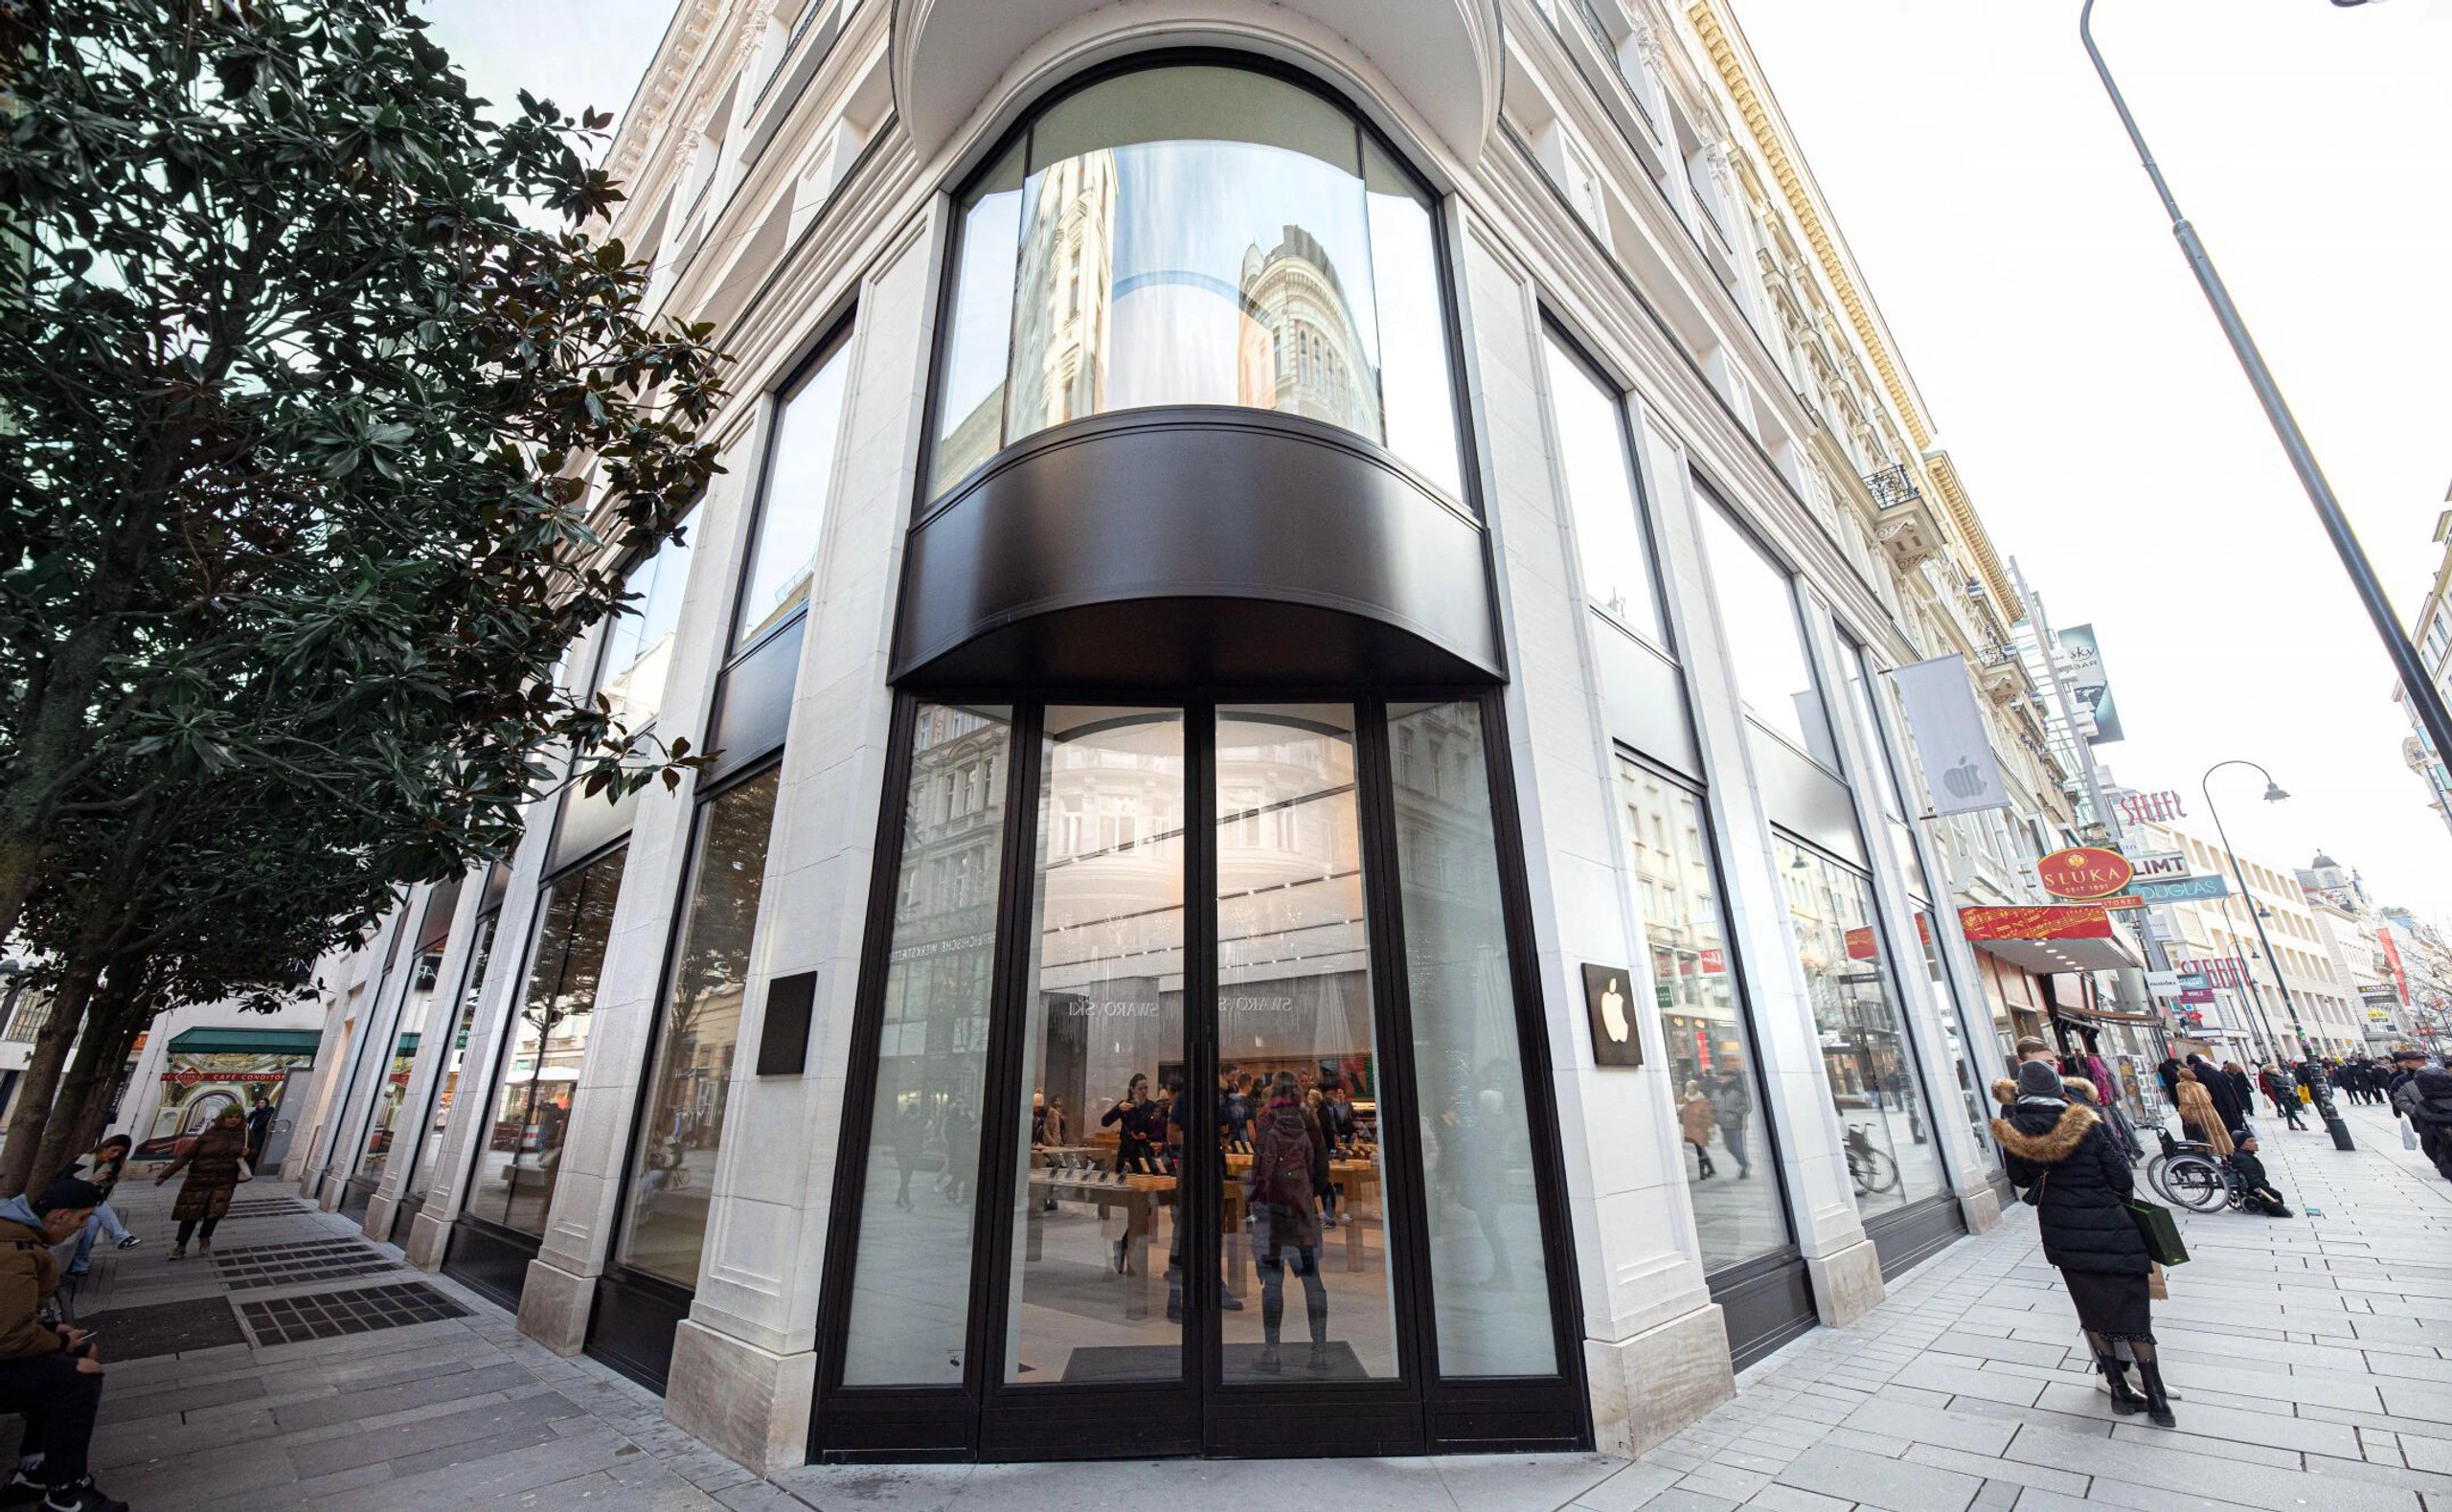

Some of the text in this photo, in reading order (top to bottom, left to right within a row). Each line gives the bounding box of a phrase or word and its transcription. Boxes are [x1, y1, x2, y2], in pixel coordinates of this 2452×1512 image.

[2070, 646, 2095, 661] sky
[2130, 856, 2183, 875] LIMT
[2044, 867, 2122, 887] SLUKA
